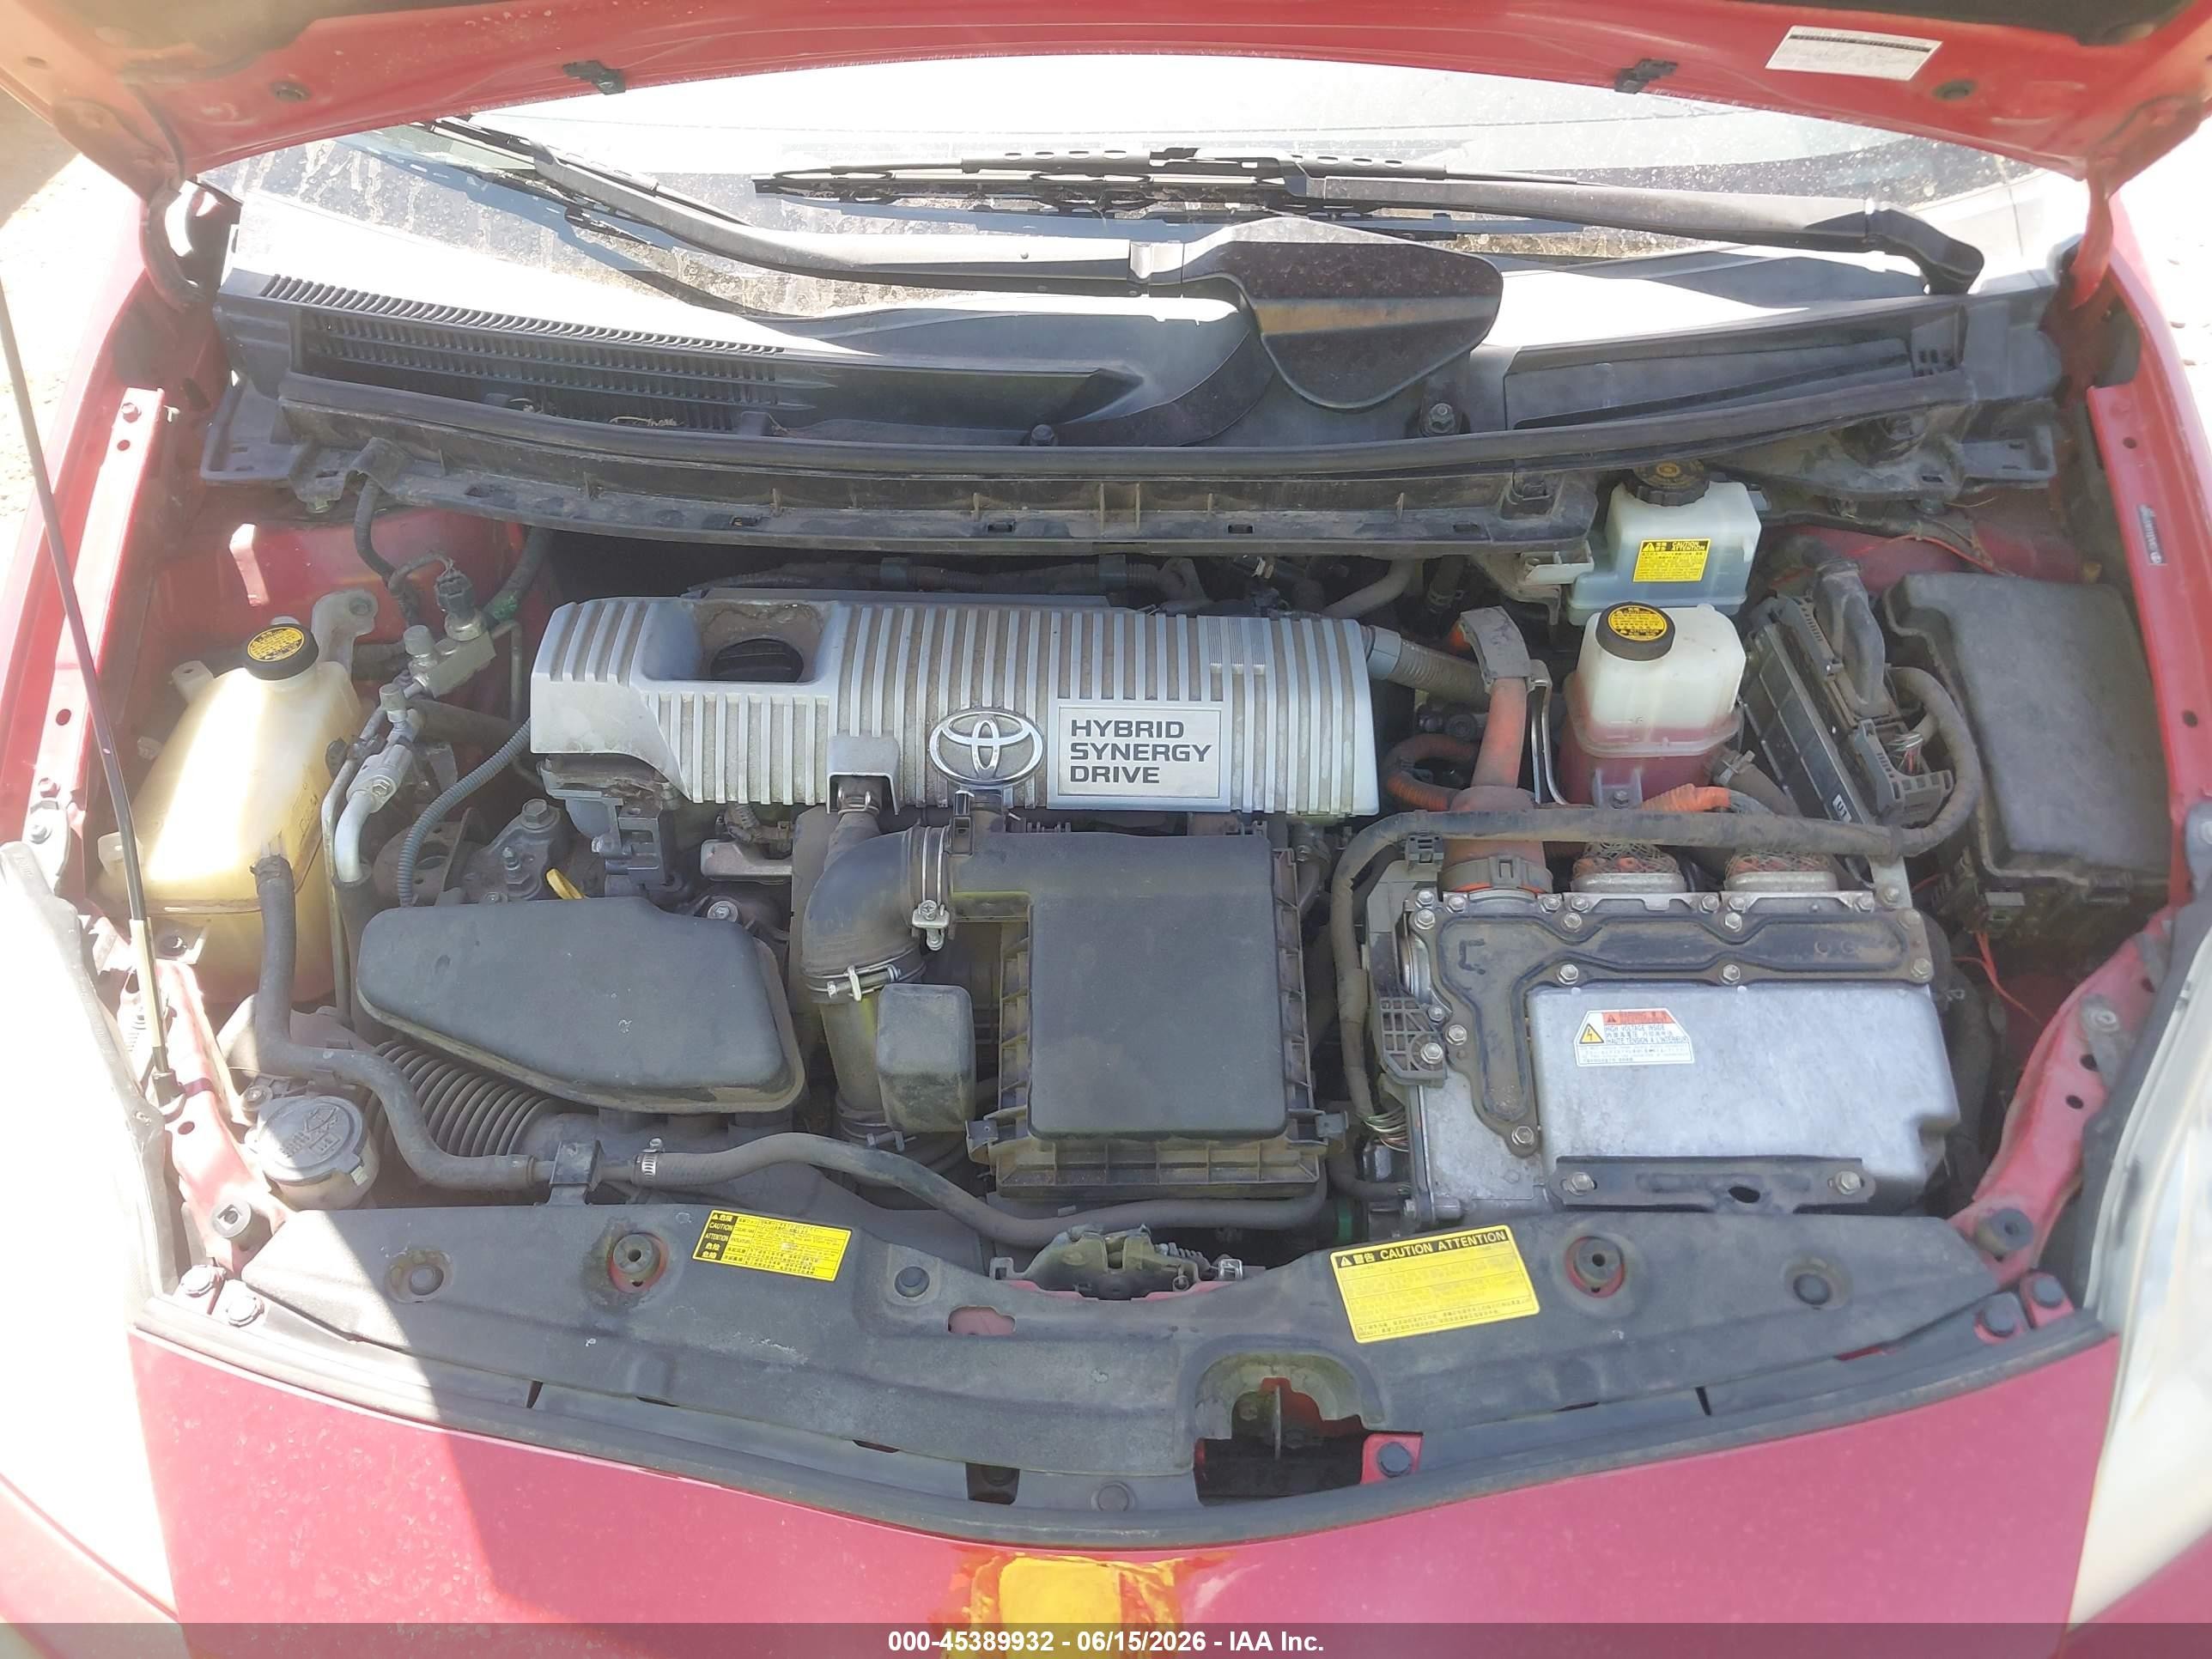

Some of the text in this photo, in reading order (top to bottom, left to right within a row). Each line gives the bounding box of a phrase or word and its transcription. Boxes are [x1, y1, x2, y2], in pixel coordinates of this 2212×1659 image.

[1071, 720, 1184, 738] HYBRID
[1070, 743, 1212, 763] SYNERGY
[1070, 765, 1160, 784] DRIVE
[709, 1222, 733, 1231] CAUTION
[704, 1232, 729, 1242] ATTENTION
[1380, 1242, 1434, 1261] CAUTION
[1437, 1230, 1507, 1251] ATTENTION
